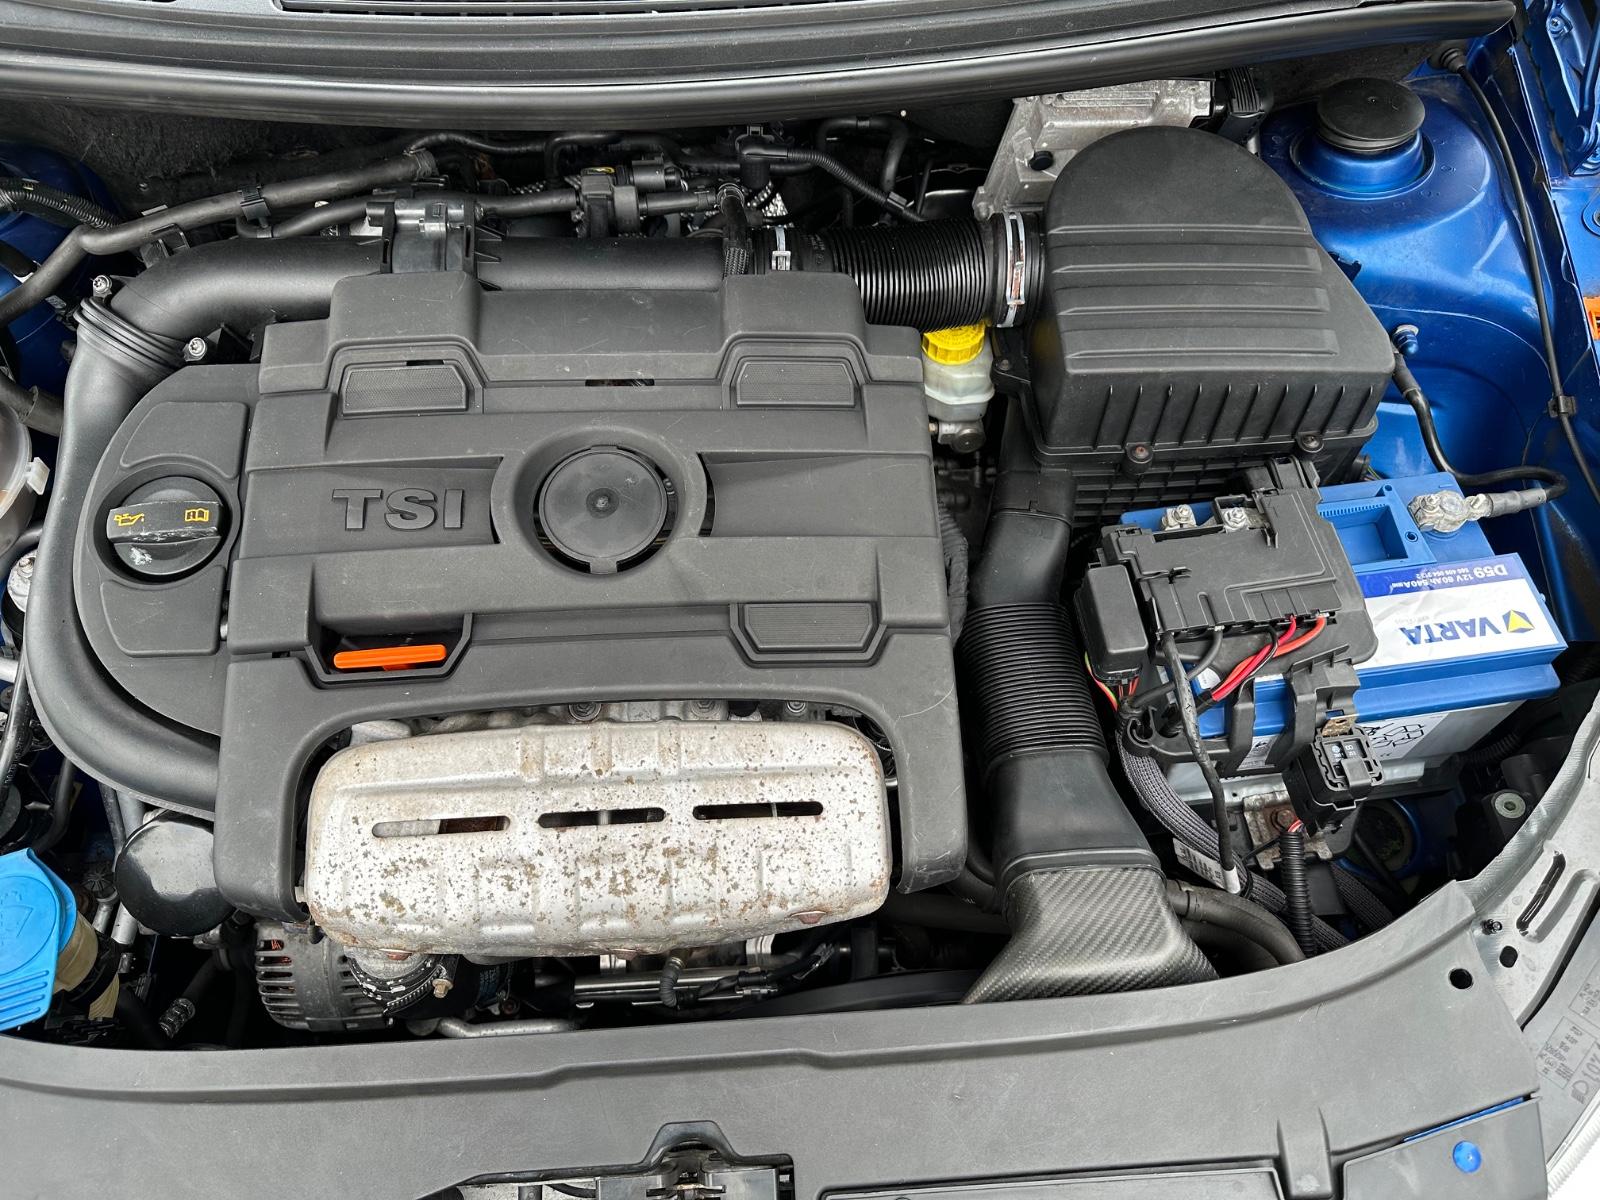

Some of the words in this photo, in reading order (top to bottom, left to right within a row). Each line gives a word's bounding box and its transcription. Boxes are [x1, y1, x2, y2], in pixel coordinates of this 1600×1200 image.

[331, 487, 465, 532] TSI
[1473, 564, 1508, 578] D59
[1429, 576, 1454, 585] 60Ah
[1456, 574, 1473, 583] 12V
[1400, 617, 1502, 645] VARTA
